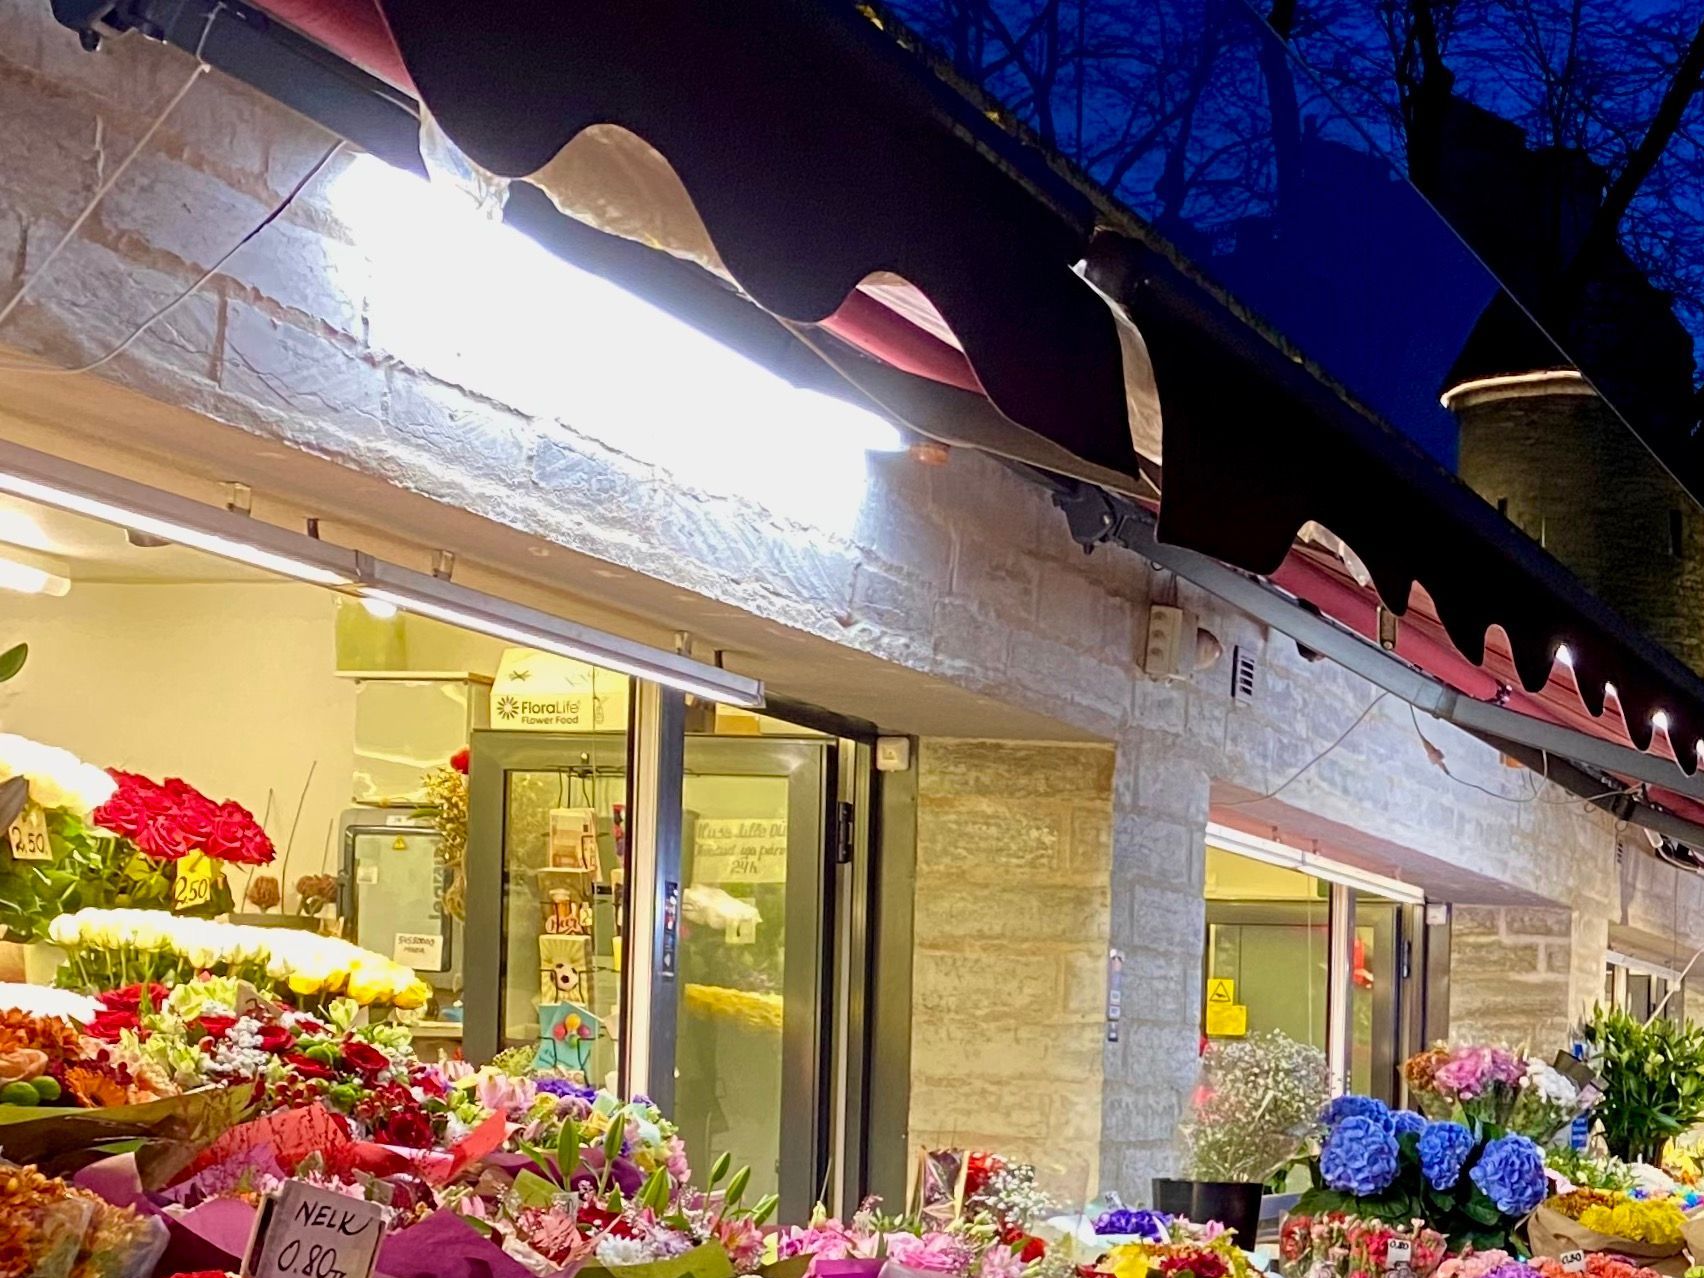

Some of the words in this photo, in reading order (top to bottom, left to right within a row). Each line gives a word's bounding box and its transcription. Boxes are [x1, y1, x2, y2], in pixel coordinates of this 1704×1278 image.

[521, 700, 579, 714] FloraLife
[521, 715, 554, 724] Flower
[555, 715, 579, 724] Food
[294, 1200, 369, 1236] NELK
